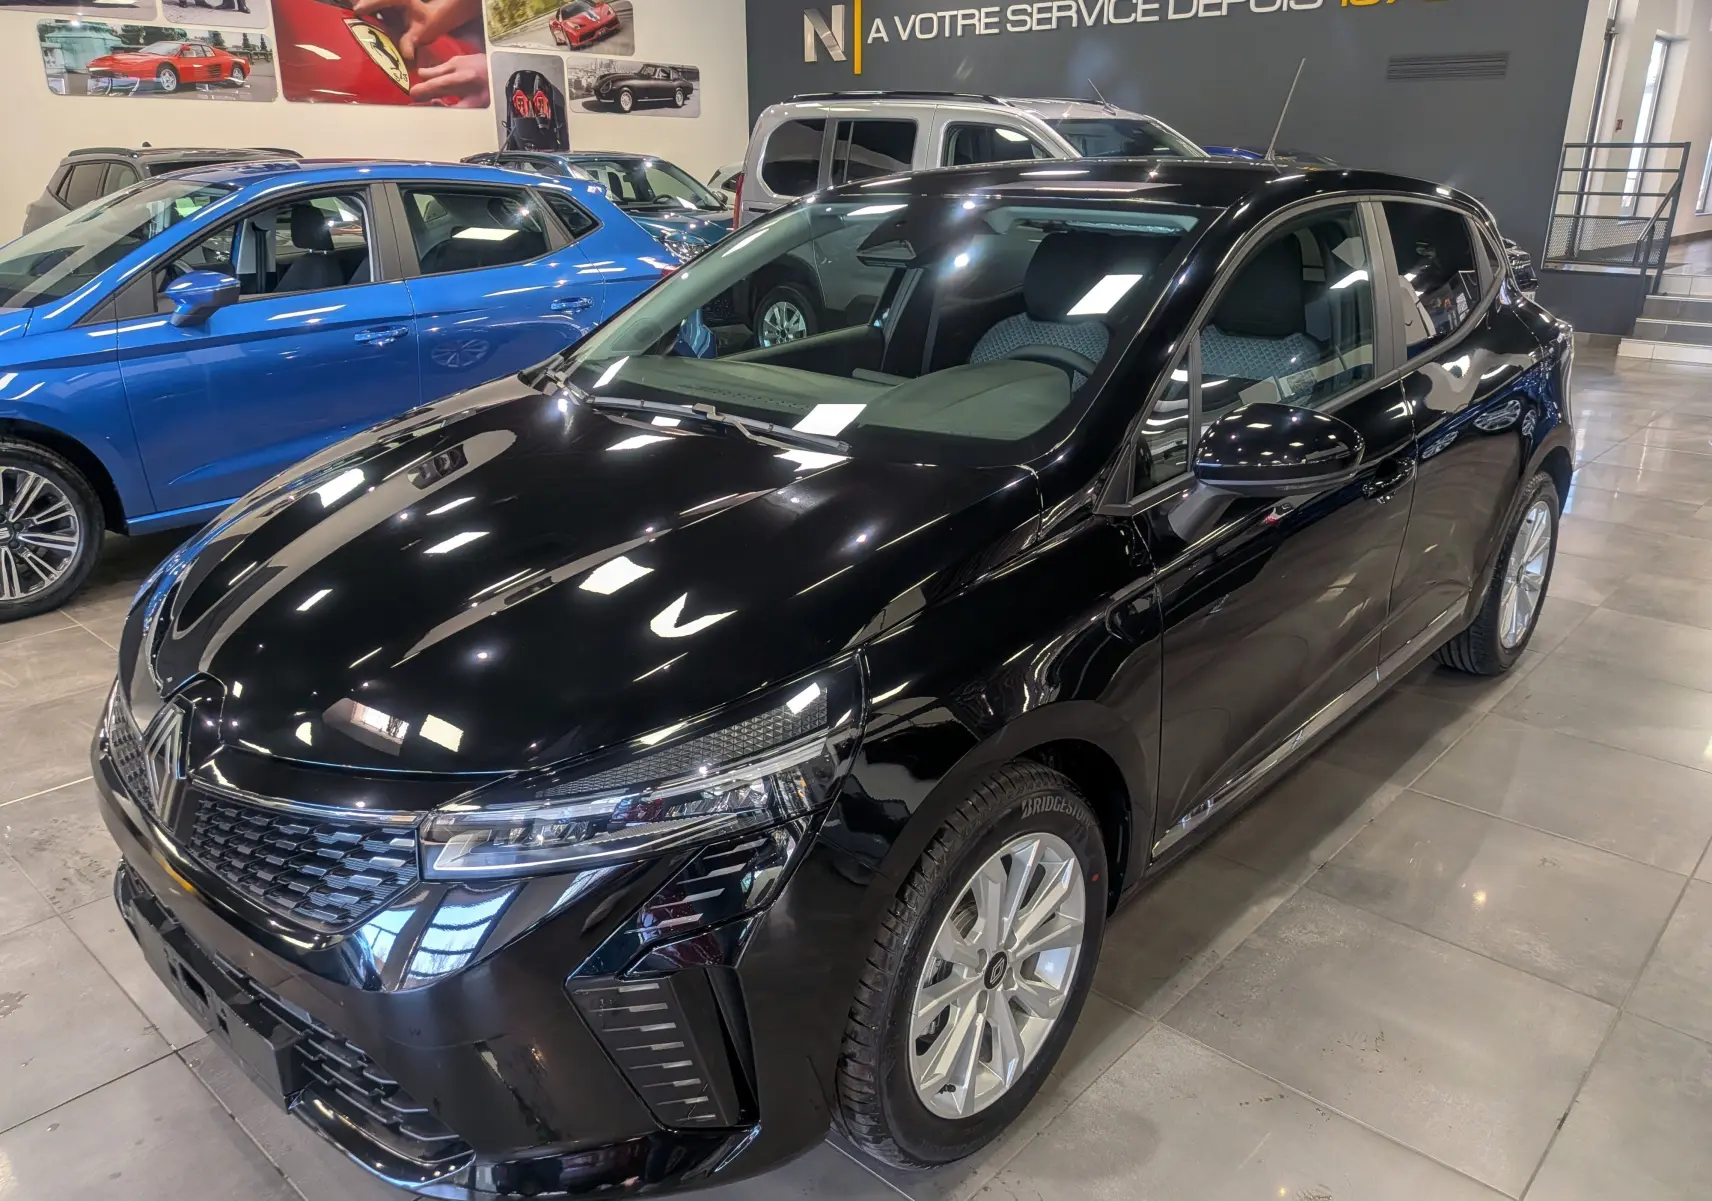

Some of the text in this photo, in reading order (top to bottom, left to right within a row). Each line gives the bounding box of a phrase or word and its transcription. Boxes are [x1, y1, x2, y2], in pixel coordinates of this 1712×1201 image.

[803, 5, 847, 62] N
[867, 18, 889, 43] A
[894, 6, 1000, 41] VOTRE
[1006, 0, 1160, 32] SERVICE
